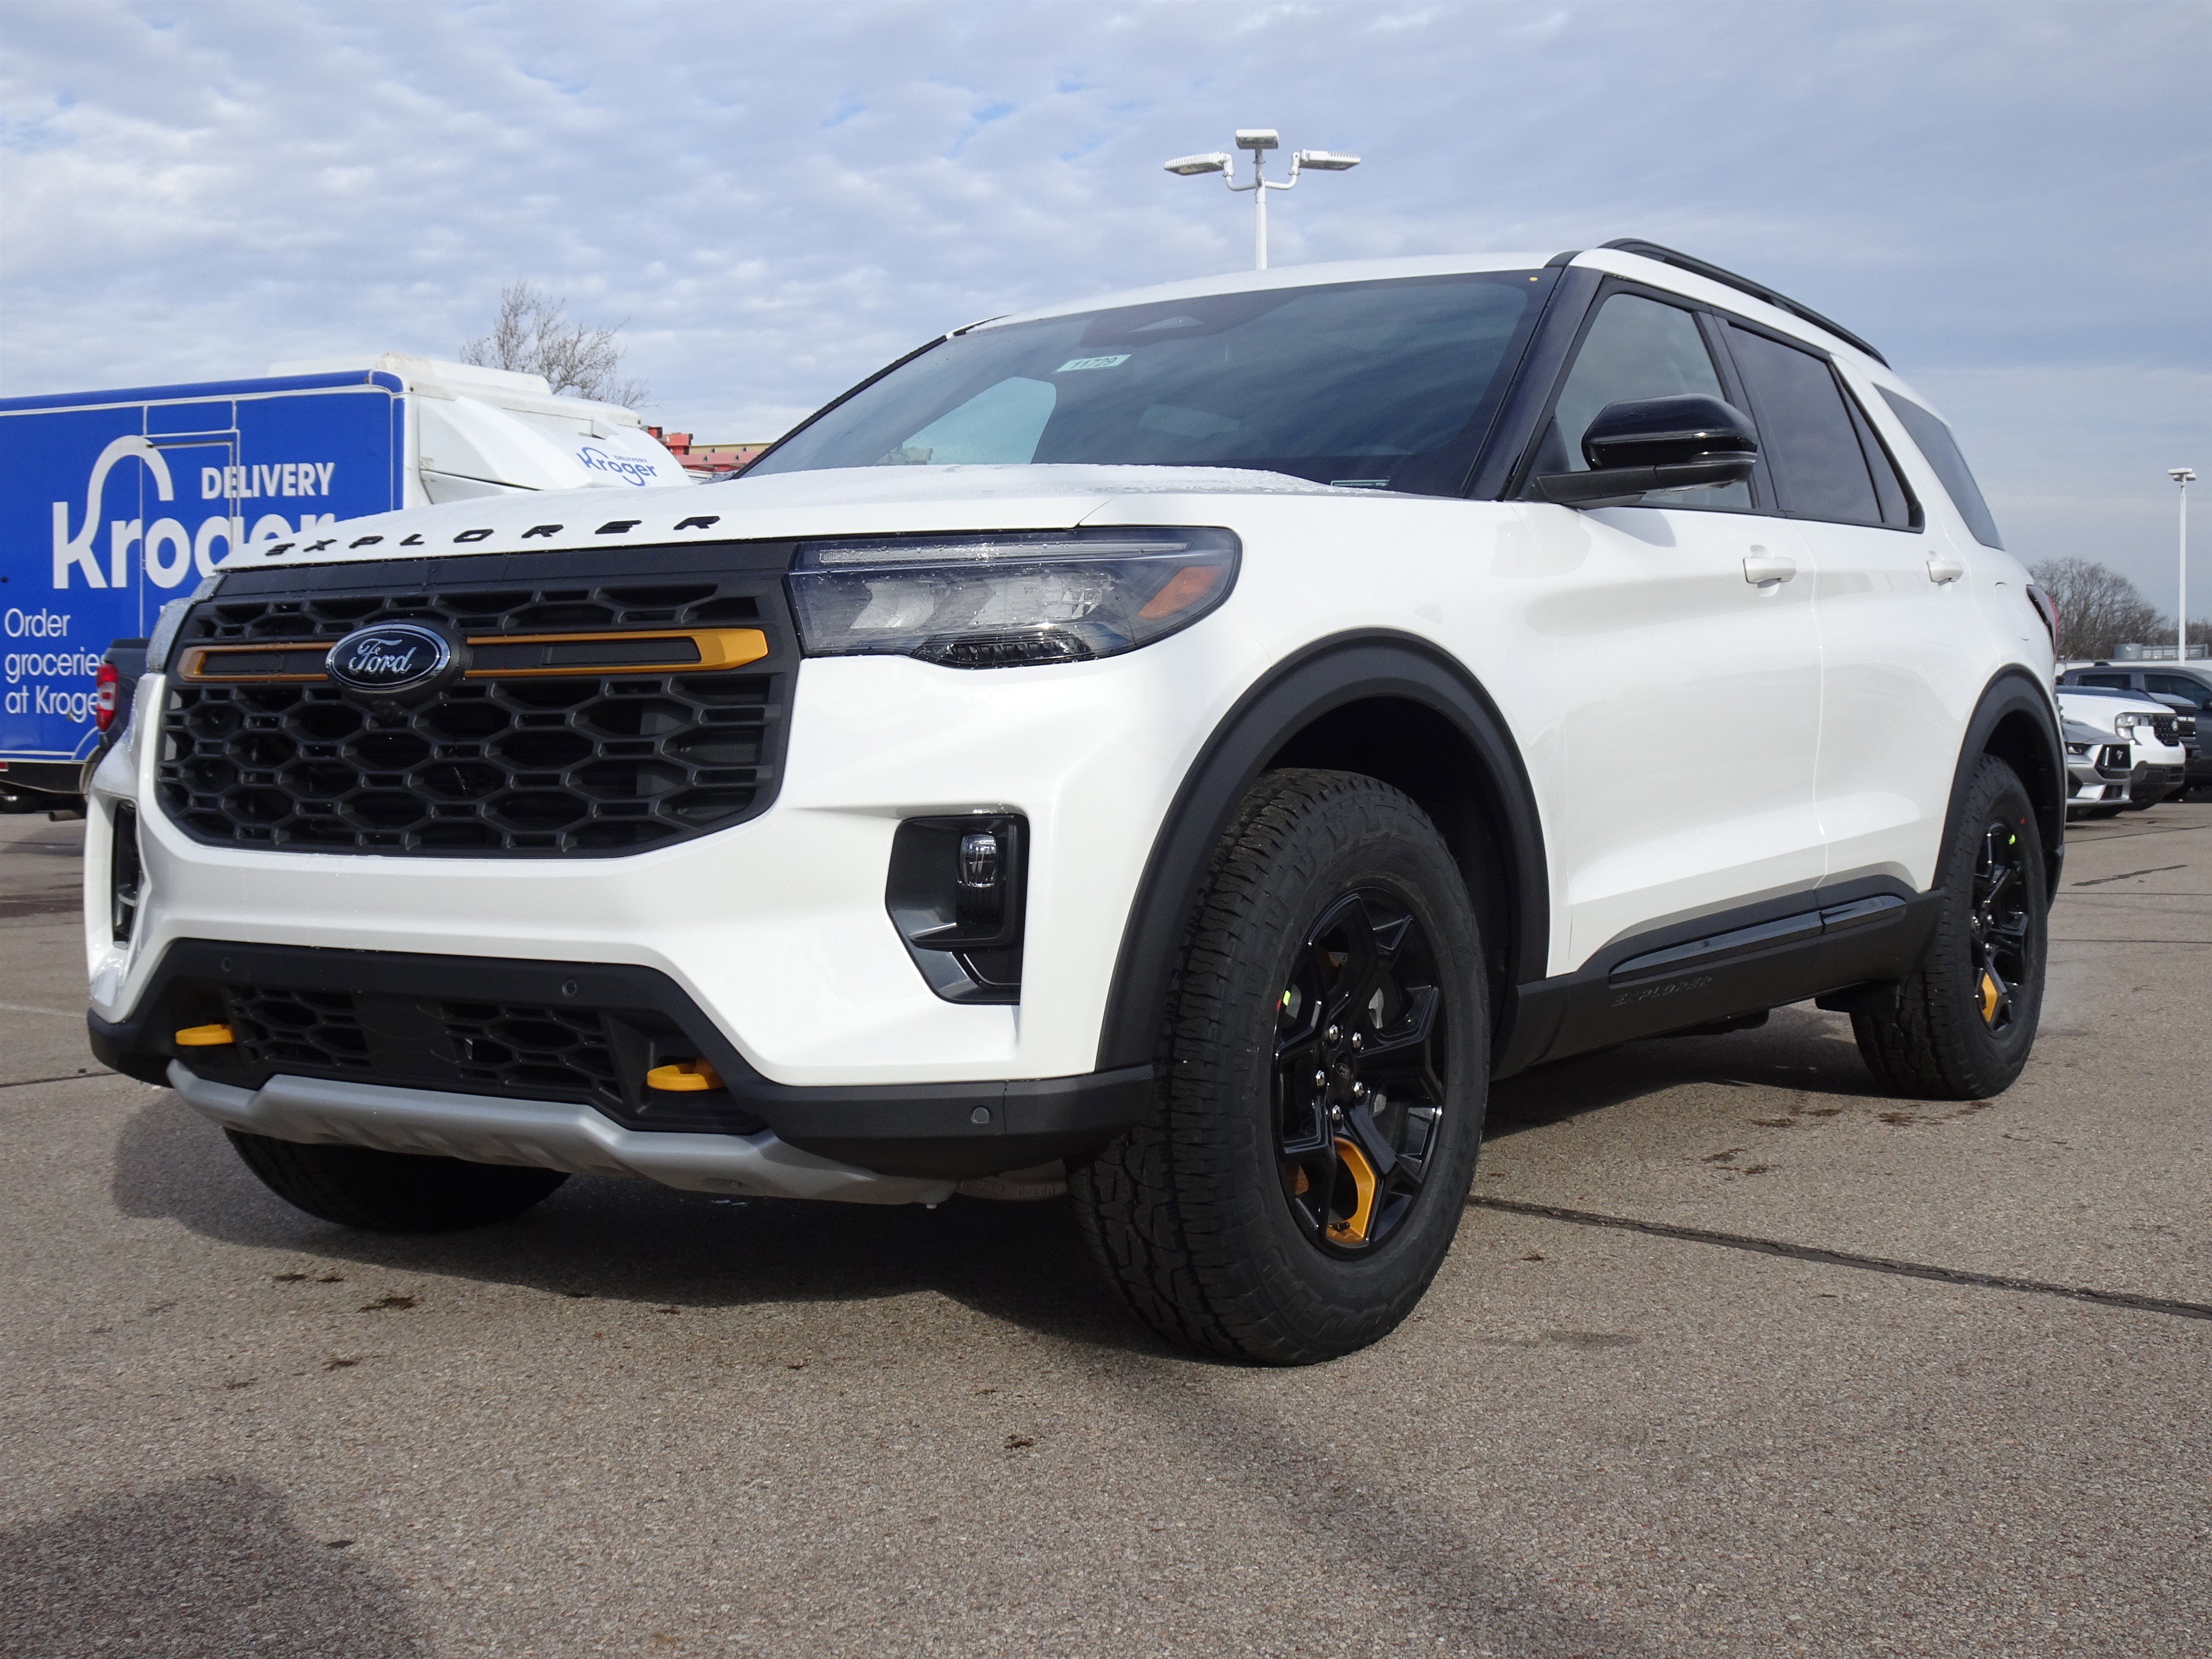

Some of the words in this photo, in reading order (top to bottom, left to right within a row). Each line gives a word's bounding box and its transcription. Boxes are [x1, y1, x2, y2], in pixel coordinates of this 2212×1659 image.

[1069, 356, 1118, 369] 11729
[576, 447, 658, 486] Kroger
[613, 455, 649, 463] DELIVERY
[201, 462, 335, 500] DELIVERY
[52, 435, 336, 589] Kro
[265, 515, 720, 556] EXPLORER
[4, 608, 71, 637] Order
[348, 638, 417, 675] Ford
[5, 685, 29, 714] at
[36, 685, 99, 723] Kroge
